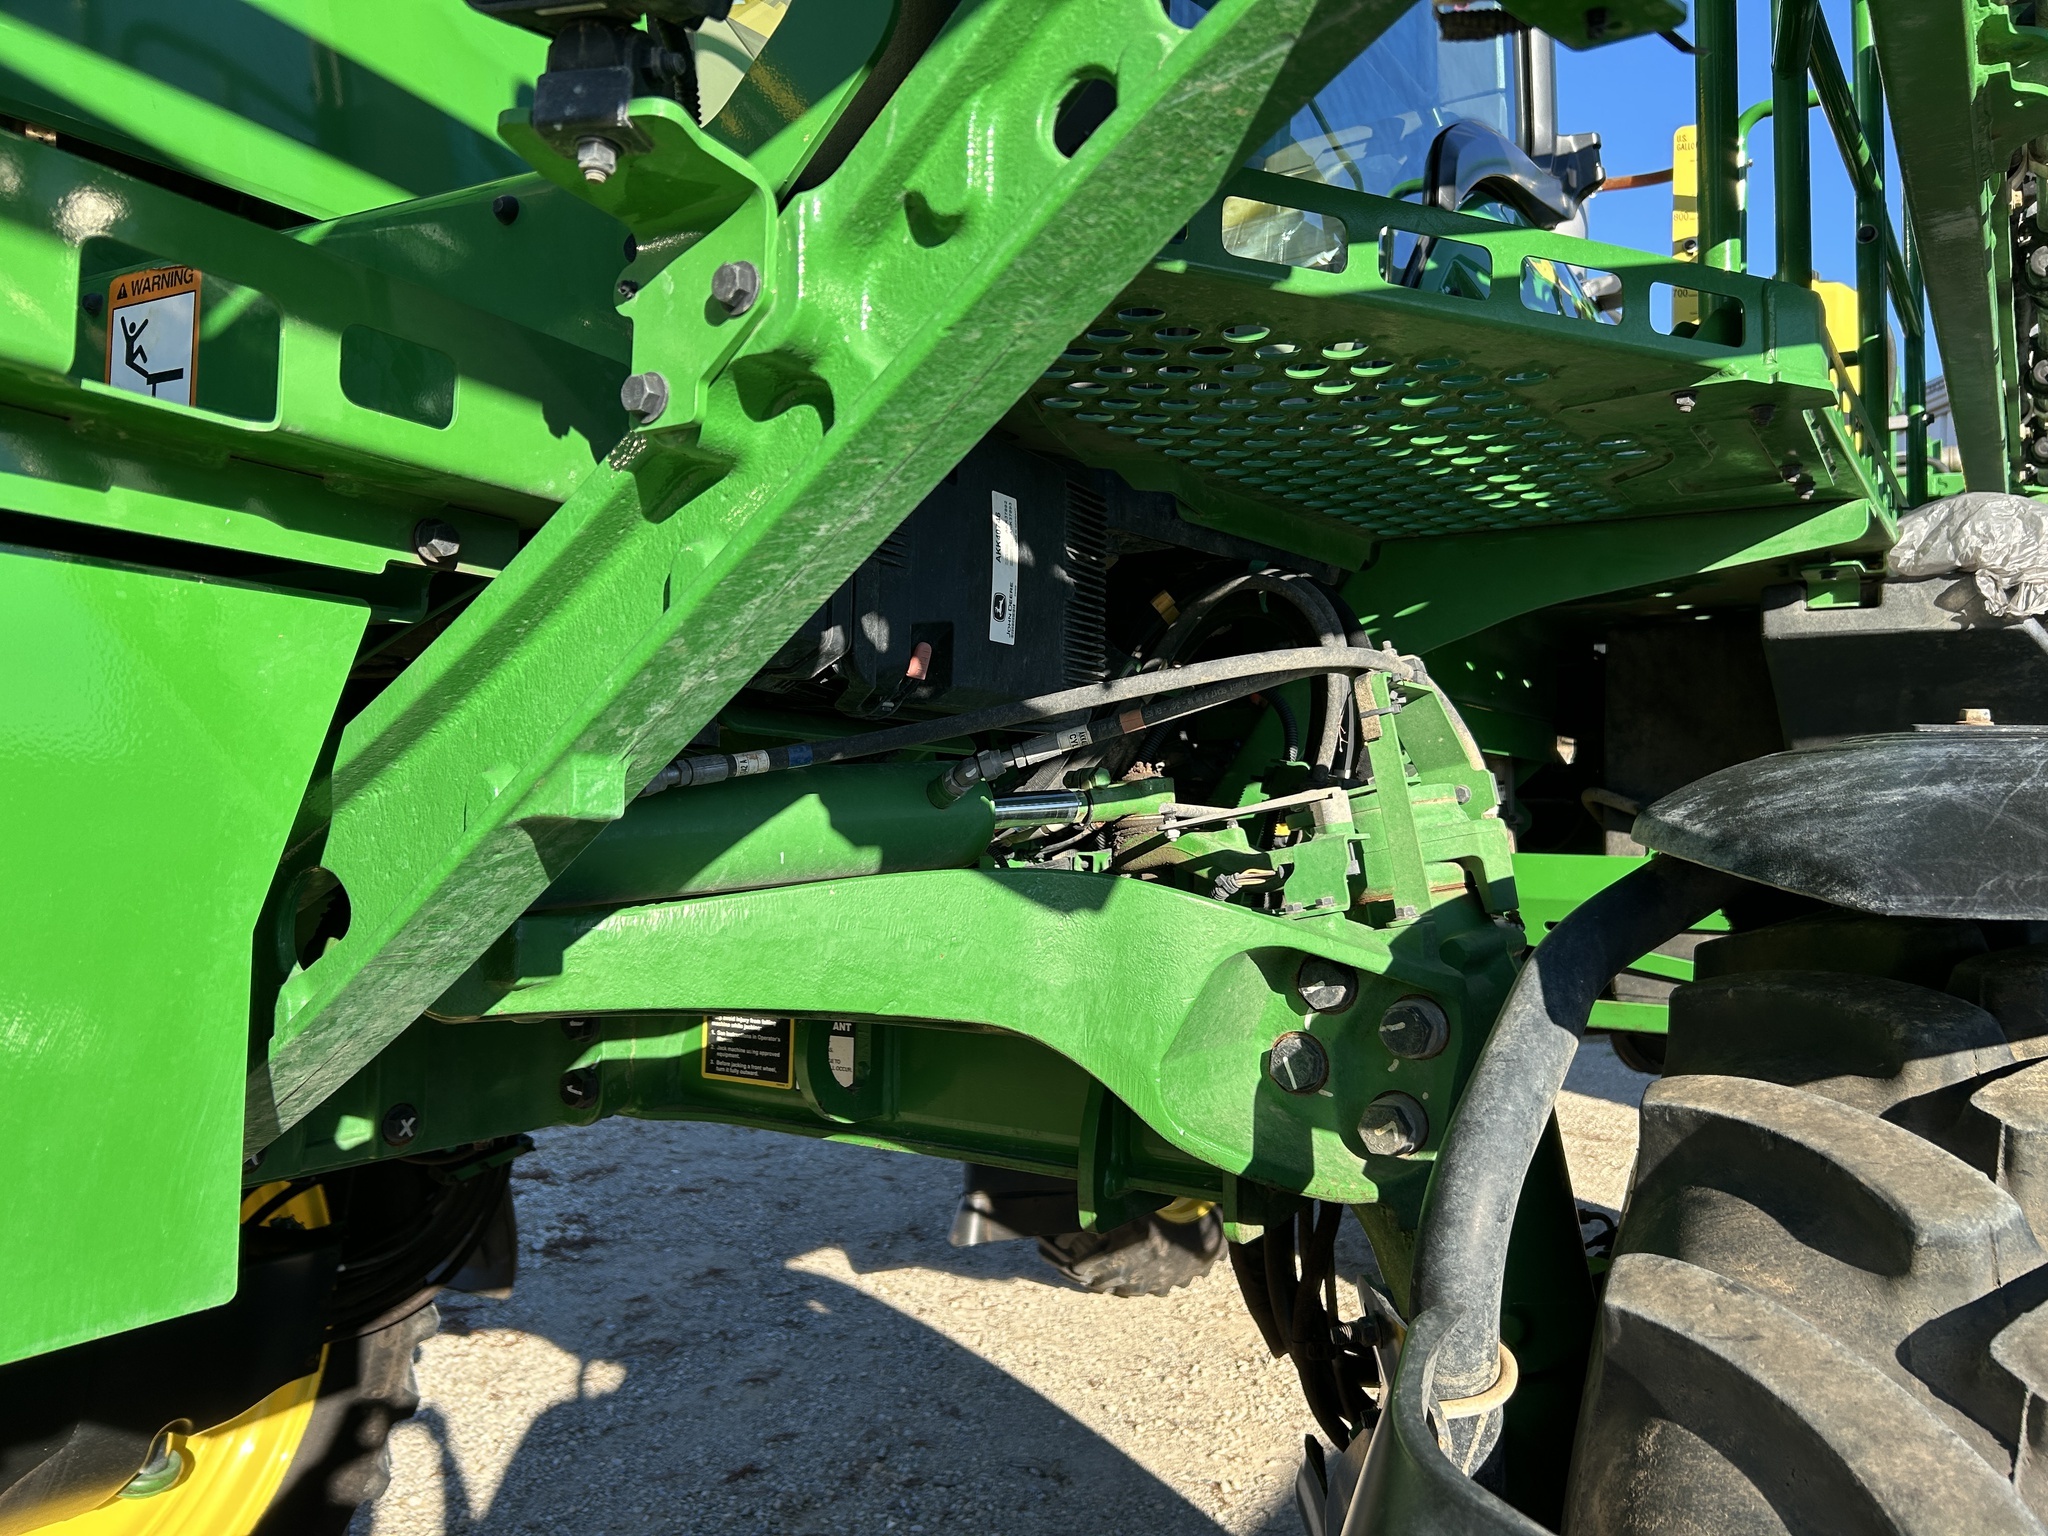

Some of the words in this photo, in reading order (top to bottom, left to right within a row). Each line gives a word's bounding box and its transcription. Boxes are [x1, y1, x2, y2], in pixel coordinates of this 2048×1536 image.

[1676, 143, 1695, 151] GALLO
[131, 268, 194, 296] WARNING
[1673, 288, 1688, 298] 700
[757, 1034, 781, 1042] Operator's
[759, 1050, 780, 1058] approved
[730, 1061, 747, 1070] jacking
[729, 1067, 739, 1075] fully
